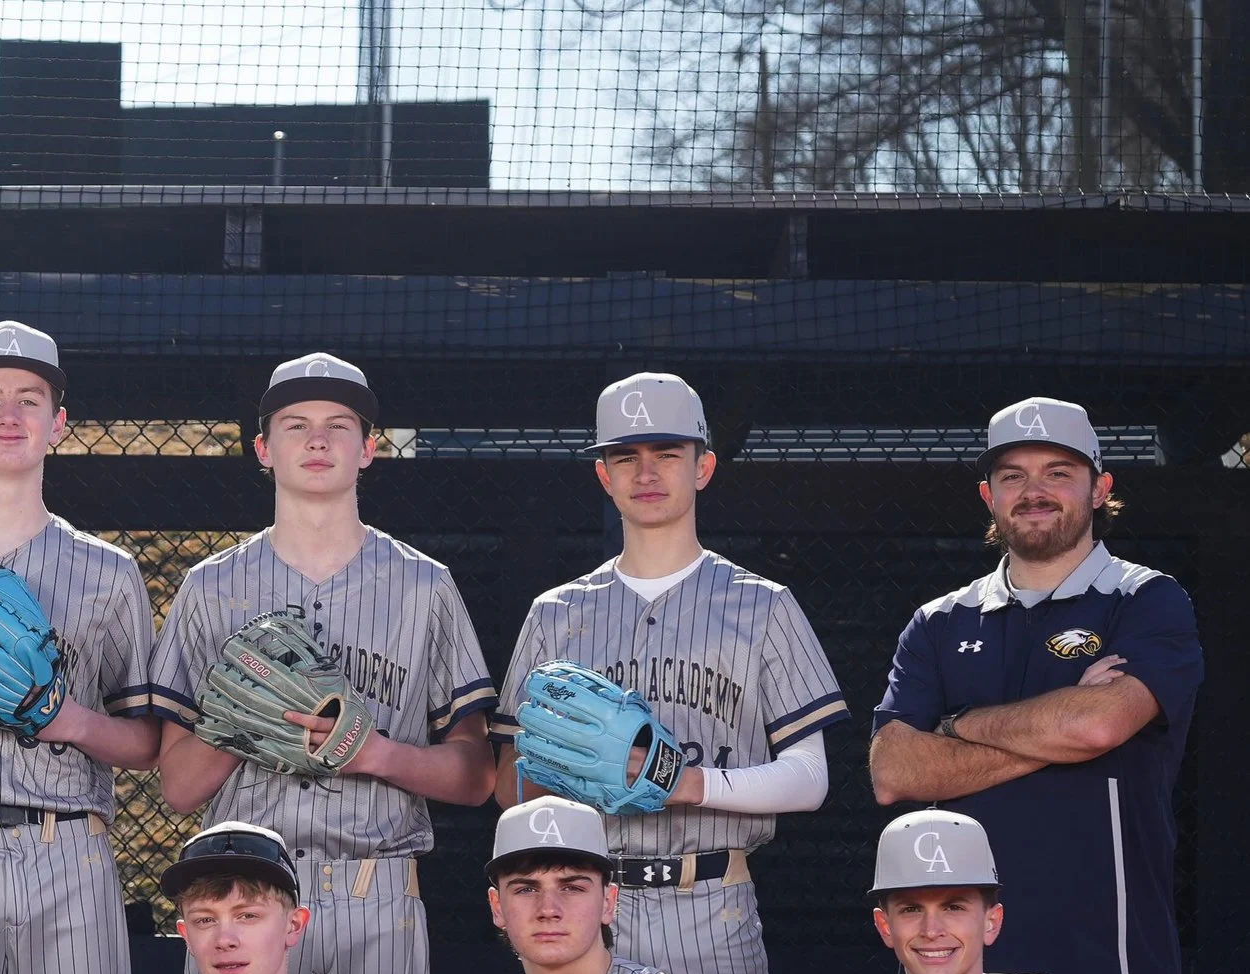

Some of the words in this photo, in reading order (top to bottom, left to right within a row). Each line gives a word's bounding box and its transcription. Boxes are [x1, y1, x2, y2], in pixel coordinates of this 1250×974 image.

[621, 391, 655, 427] CA
[1014, 402, 1050, 438] CA
[238, 653, 271, 678] A2000
[542, 682, 576, 700] Rawlings
[648, 657, 742, 729] ACADEMY
[333, 714, 366, 759] Wilson
[657, 747, 675, 783] Rawlings
[528, 807, 567, 845] CA
[912, 832, 953, 872] CA
